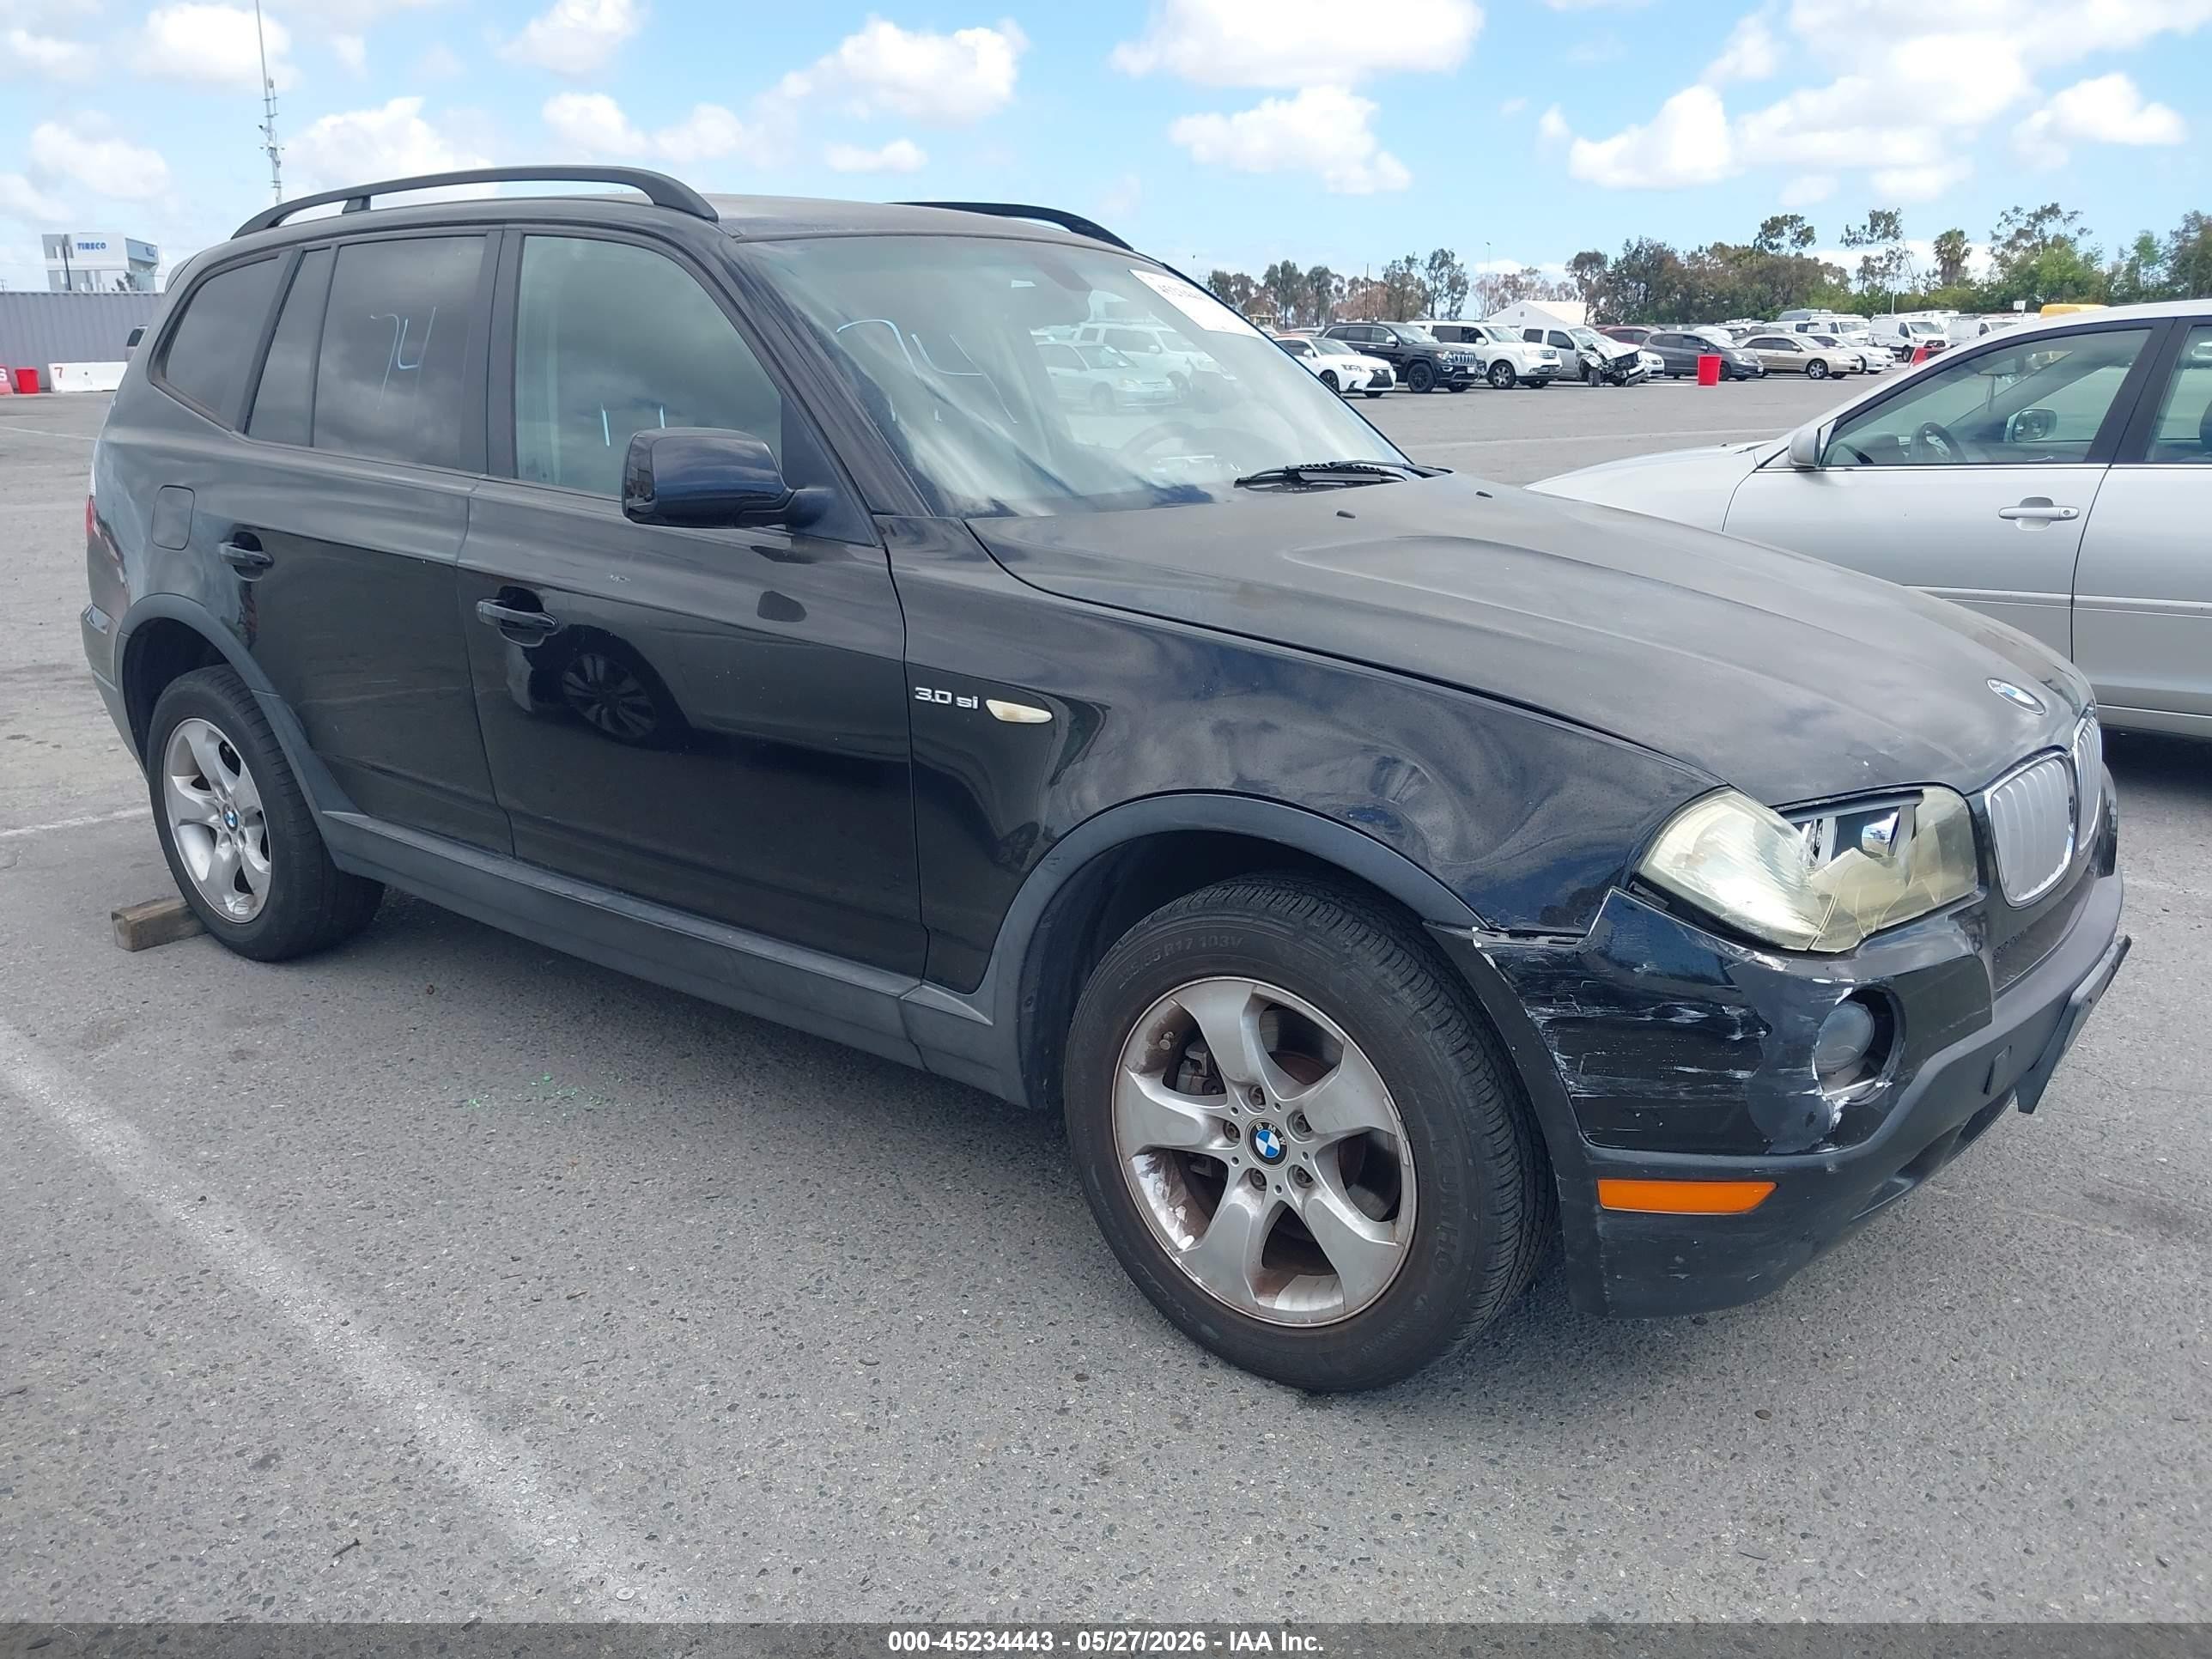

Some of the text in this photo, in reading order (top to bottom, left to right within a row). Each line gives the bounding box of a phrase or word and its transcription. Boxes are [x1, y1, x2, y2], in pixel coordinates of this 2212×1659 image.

[76, 241, 106, 251] TIRECO
[54, 367, 64, 379] 7
[915, 687, 979, 710] 3.0 si
[1255, 1121, 1287, 1146] BMW
